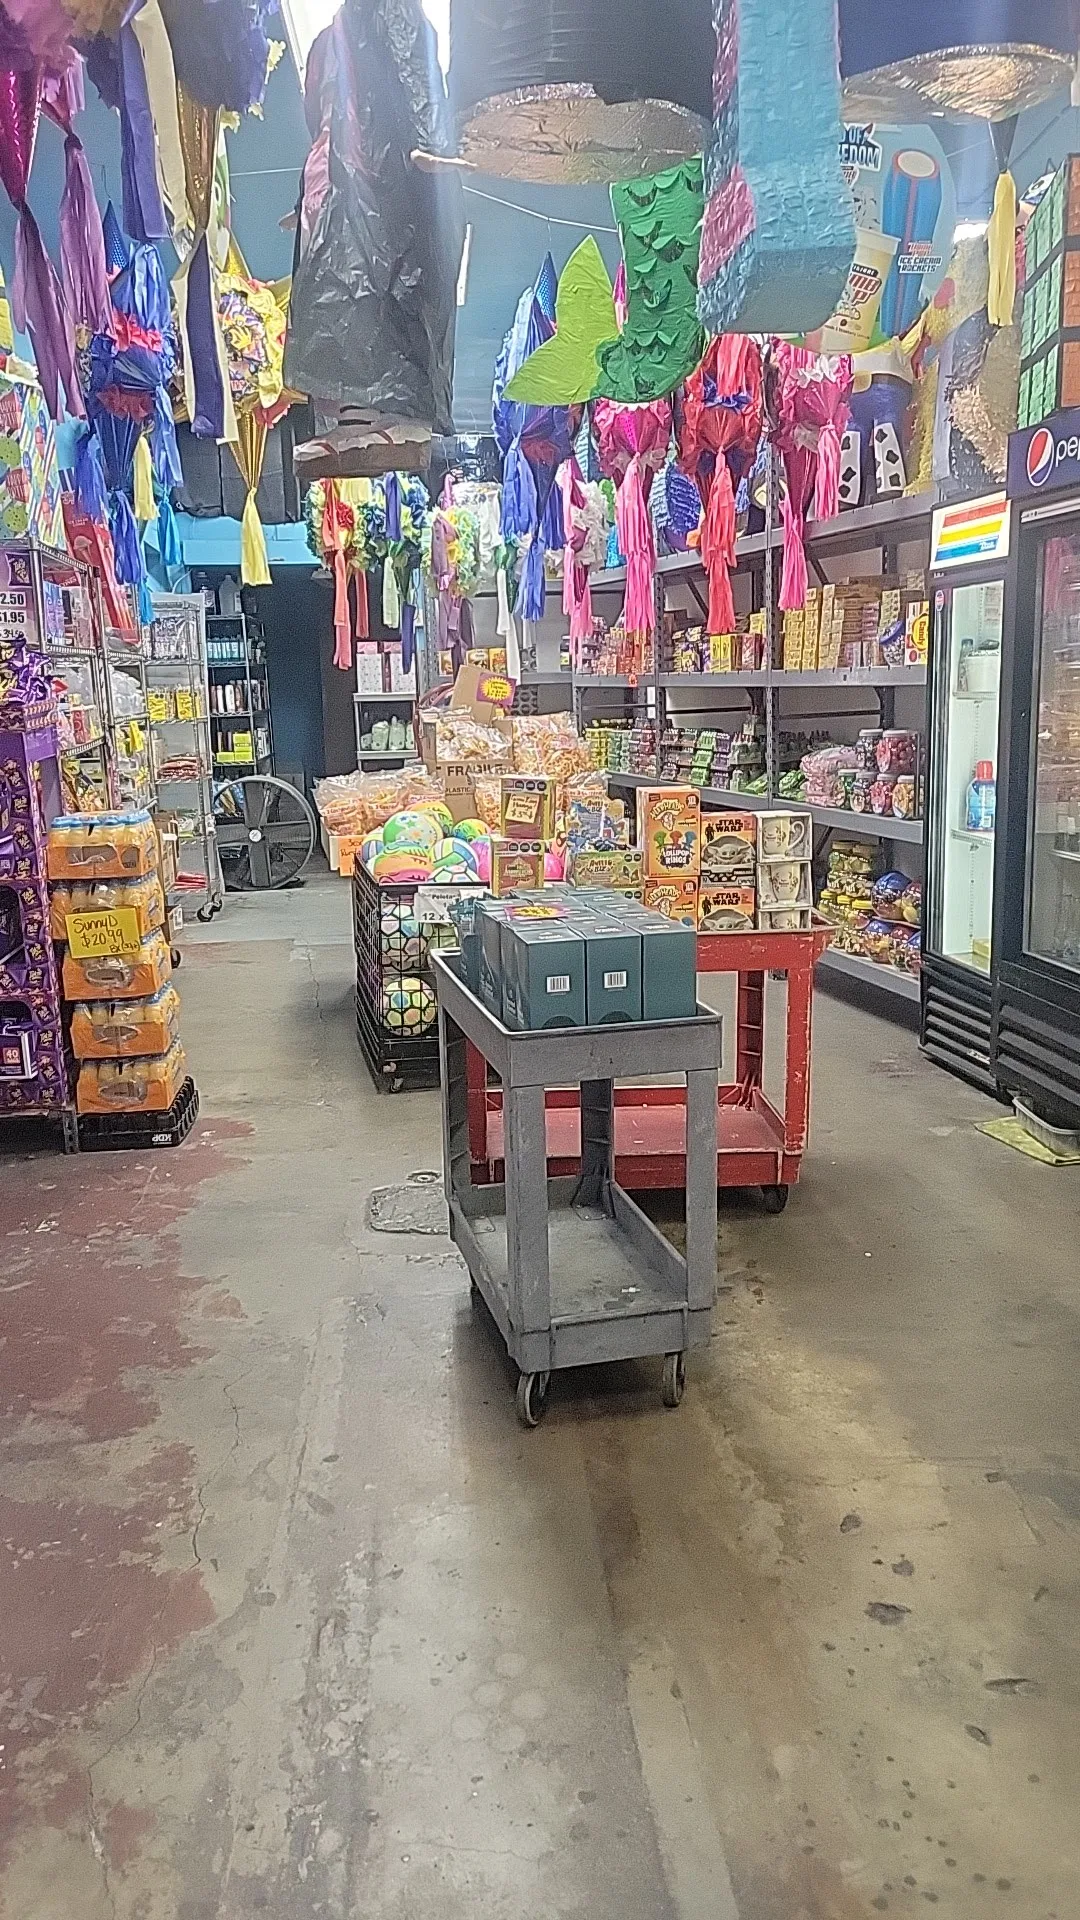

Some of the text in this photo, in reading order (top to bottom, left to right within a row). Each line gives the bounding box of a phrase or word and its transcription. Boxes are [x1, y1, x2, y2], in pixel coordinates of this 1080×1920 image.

[839, 144, 880, 168] EDOM
[917, 621, 927, 645] Candy
[73, 915, 118, 934] SunnyD
